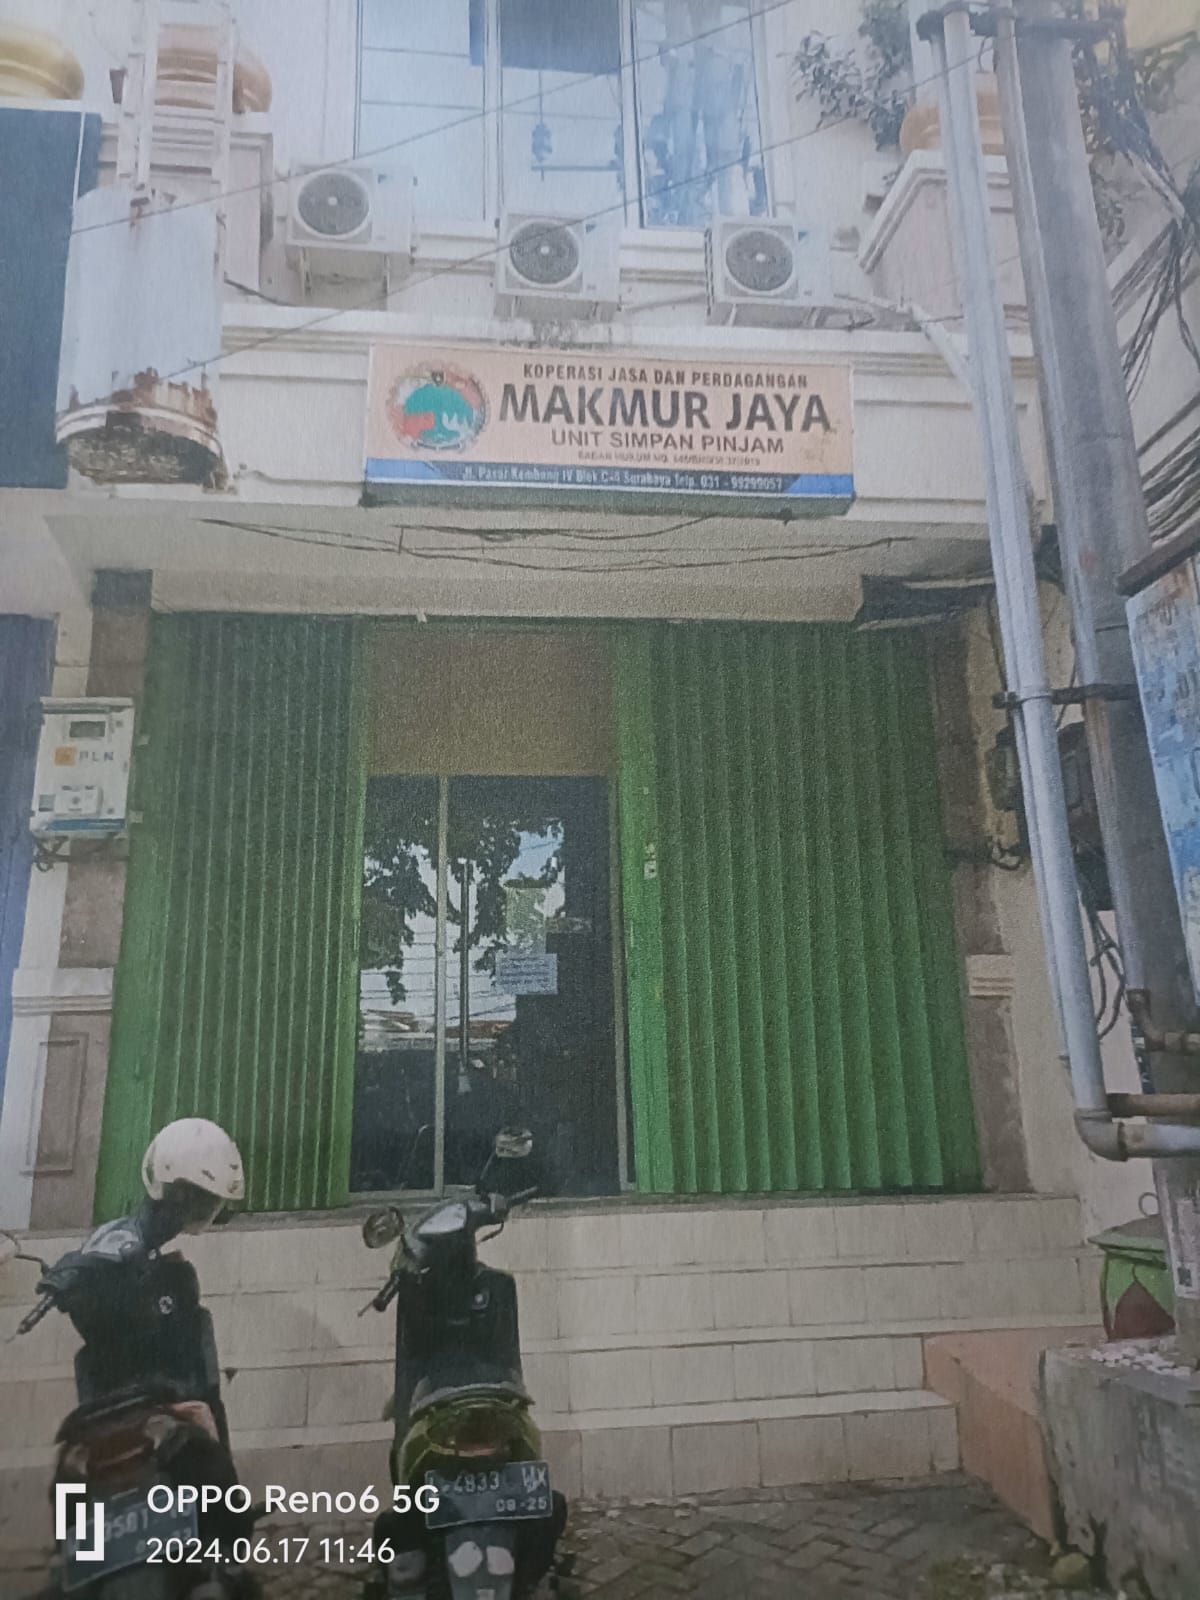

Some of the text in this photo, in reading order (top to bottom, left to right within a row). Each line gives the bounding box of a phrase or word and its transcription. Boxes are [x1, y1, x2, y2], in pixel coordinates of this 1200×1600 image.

[523, 363, 808, 389] KOPERASI JASA DAN PERDAGANGAN
[499, 383, 832, 433] MAKMUR JAYA
[551, 430, 785, 454] UNIT SIMPAN PINJAM
[624, 470, 671, 488] Surabaya
